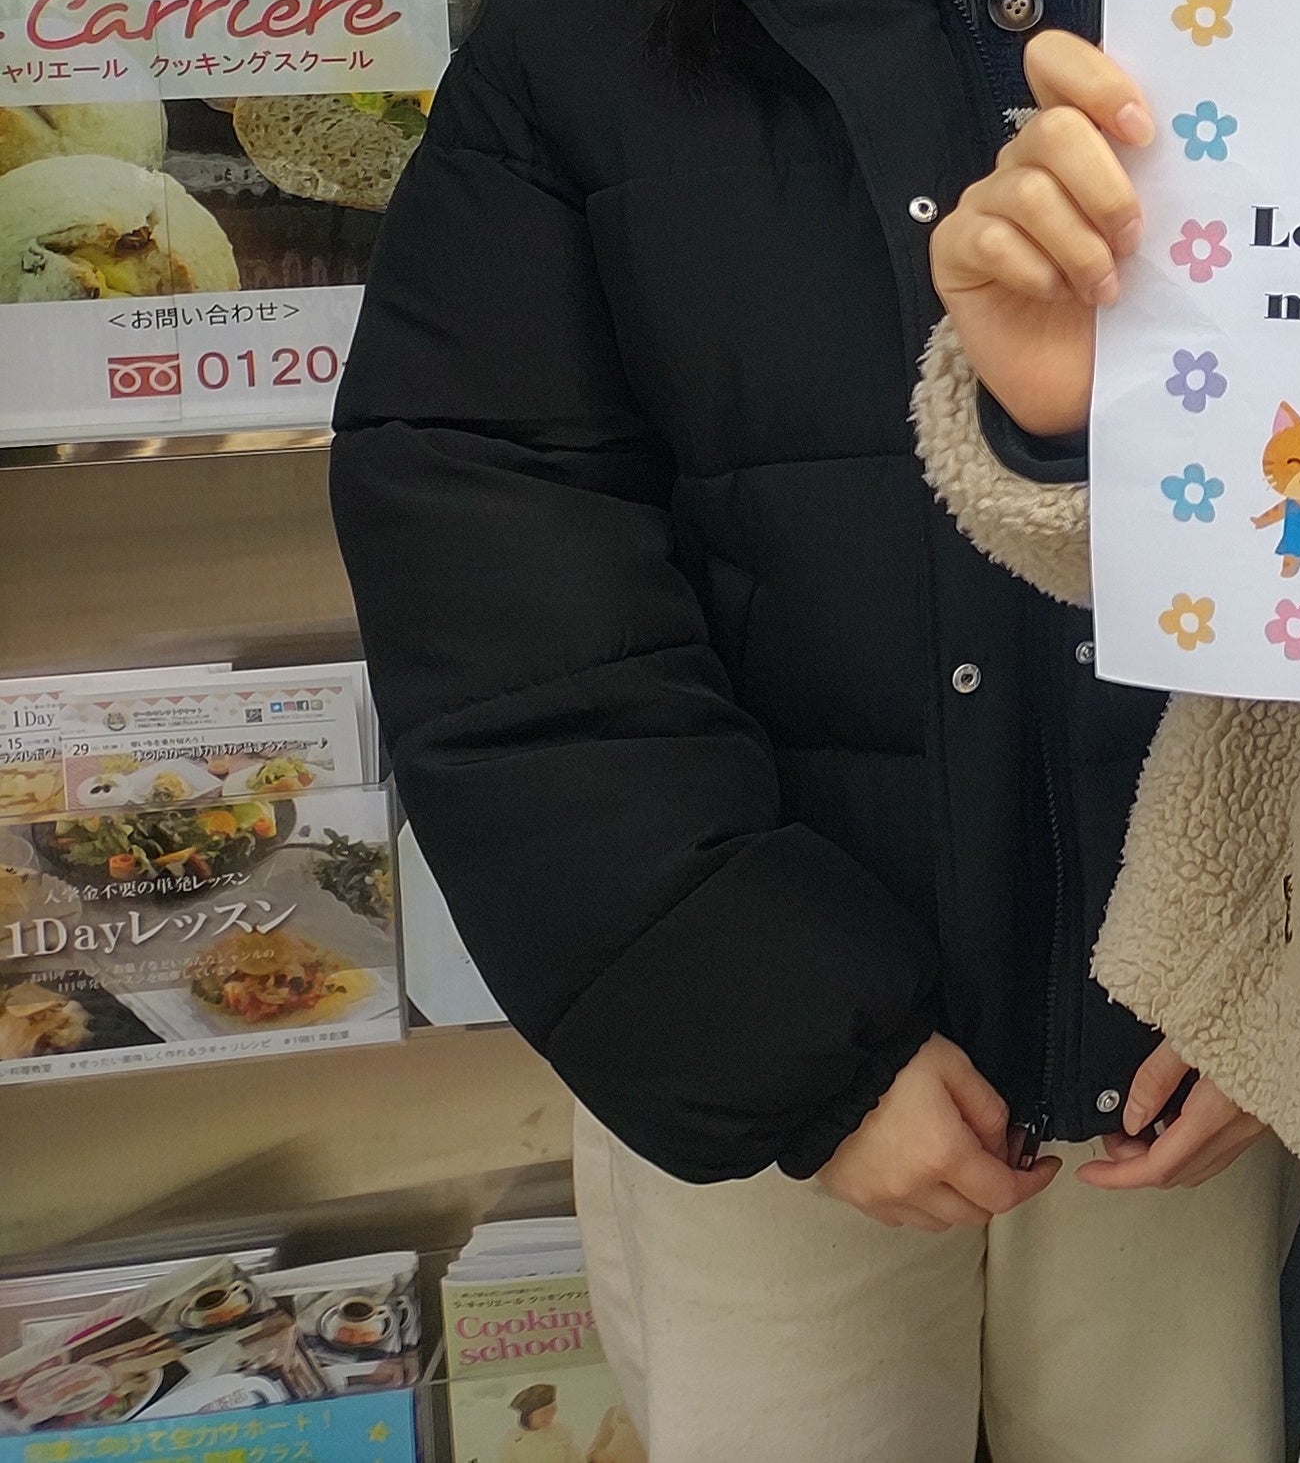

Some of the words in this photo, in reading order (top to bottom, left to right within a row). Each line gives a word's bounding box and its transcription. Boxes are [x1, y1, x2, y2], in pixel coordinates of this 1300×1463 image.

[150, 50, 374, 78] クッキングスクール
[5, 900, 298, 959] 1Dayレッスン
[459, 1327, 583, 1366] school
